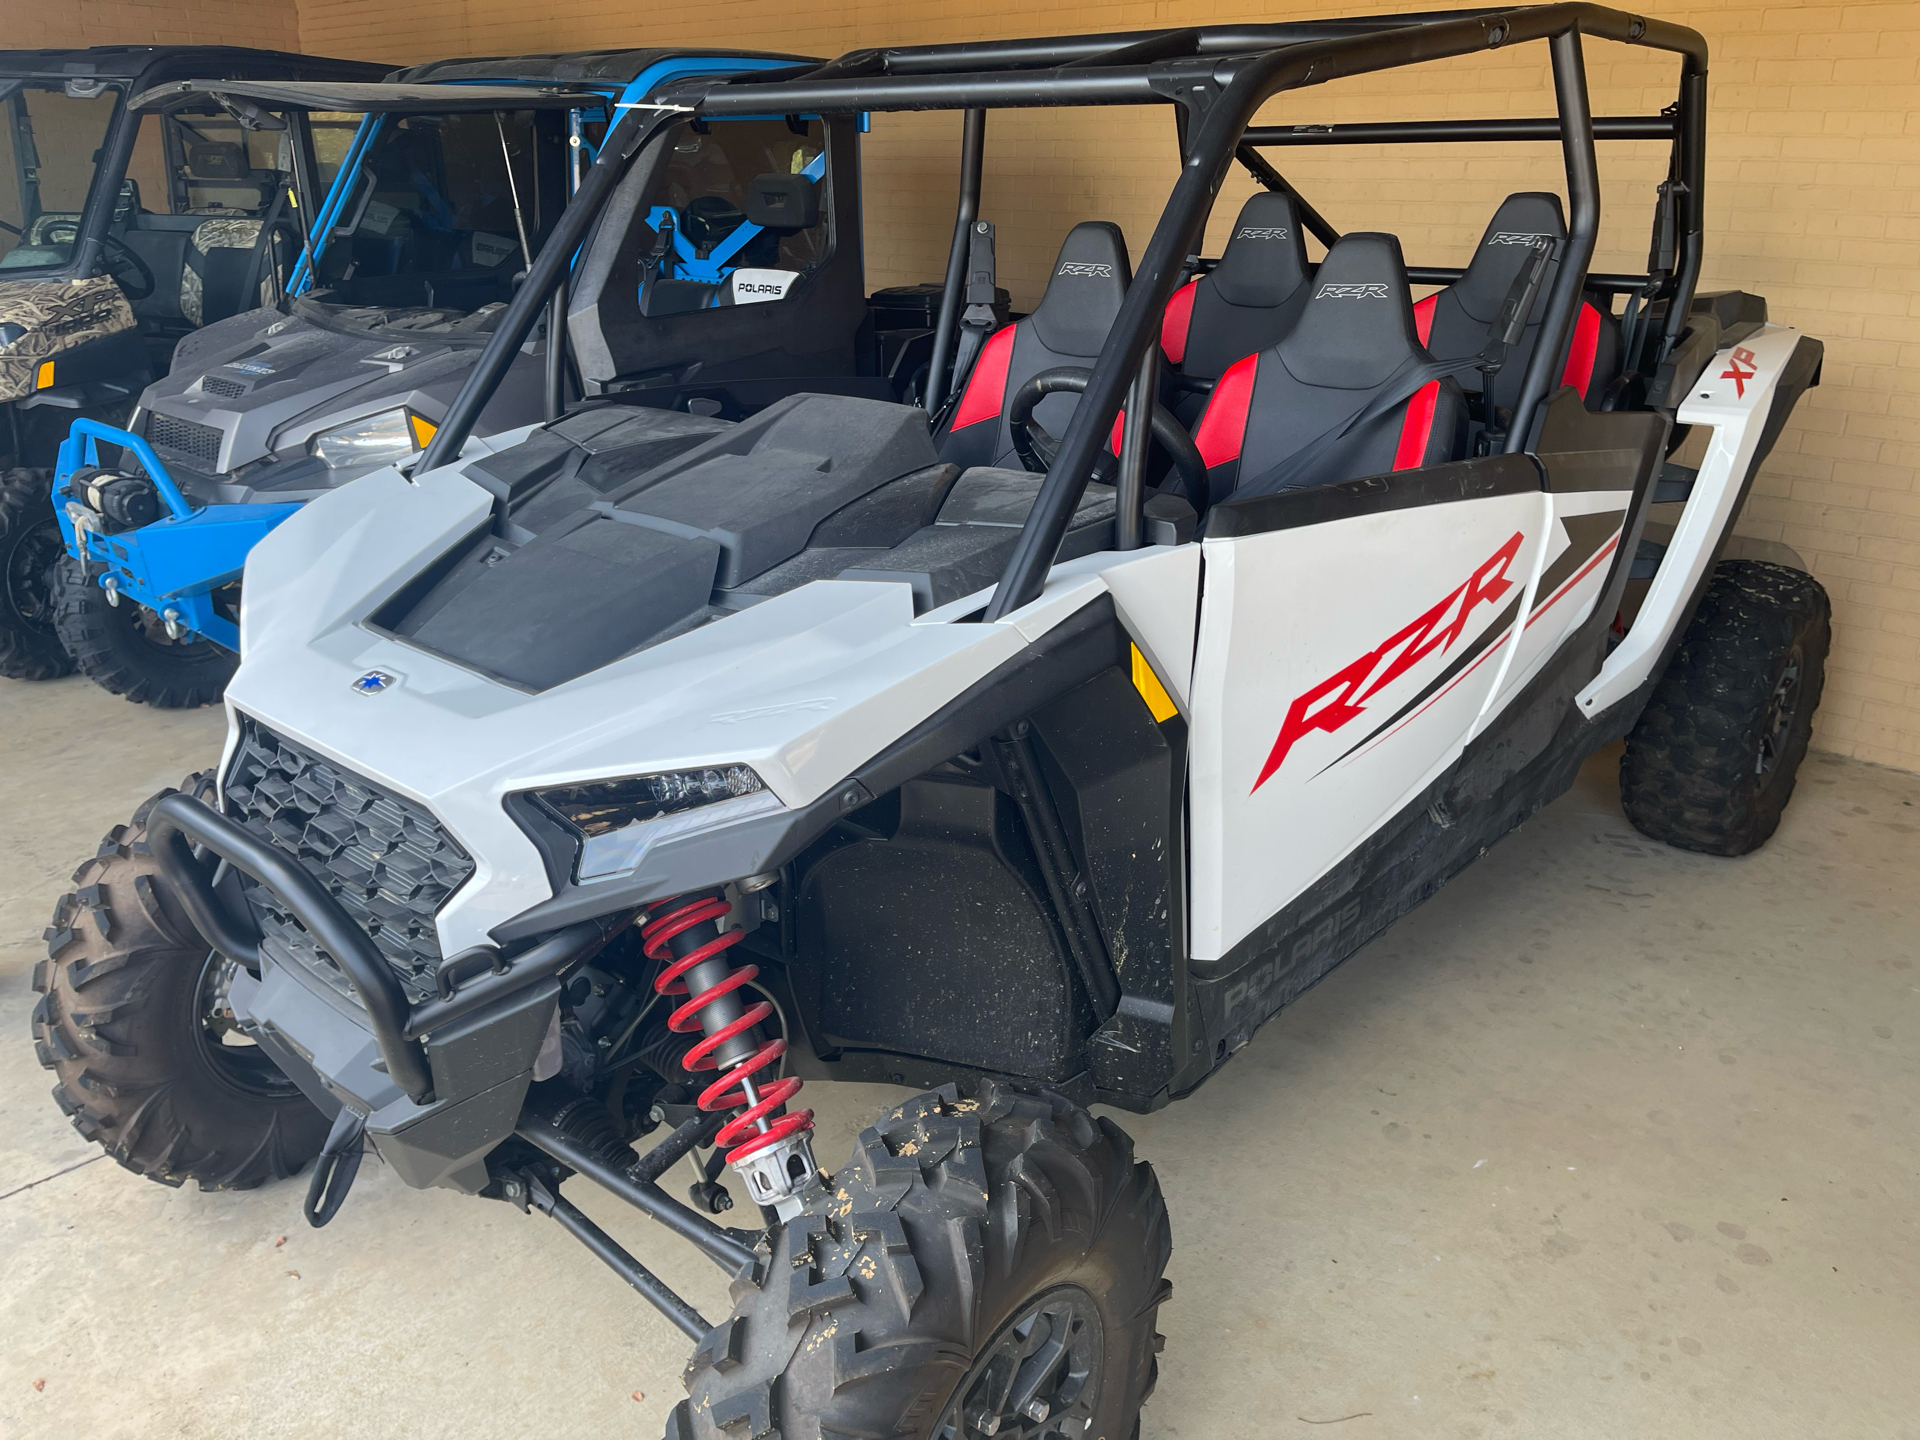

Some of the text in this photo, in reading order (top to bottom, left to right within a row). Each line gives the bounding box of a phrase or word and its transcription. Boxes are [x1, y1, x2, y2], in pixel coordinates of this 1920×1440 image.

[1237, 227, 1287, 239] RZR
[1058, 262, 1112, 277] RZR
[738, 283, 782, 295] POLARIS
[1315, 283, 1388, 299] RZR
[41, 288, 117, 328] XP
[1719, 346, 1758, 400] XP
[1249, 530, 1525, 796] RZR
[1224, 896, 1362, 1022] POLARIS
